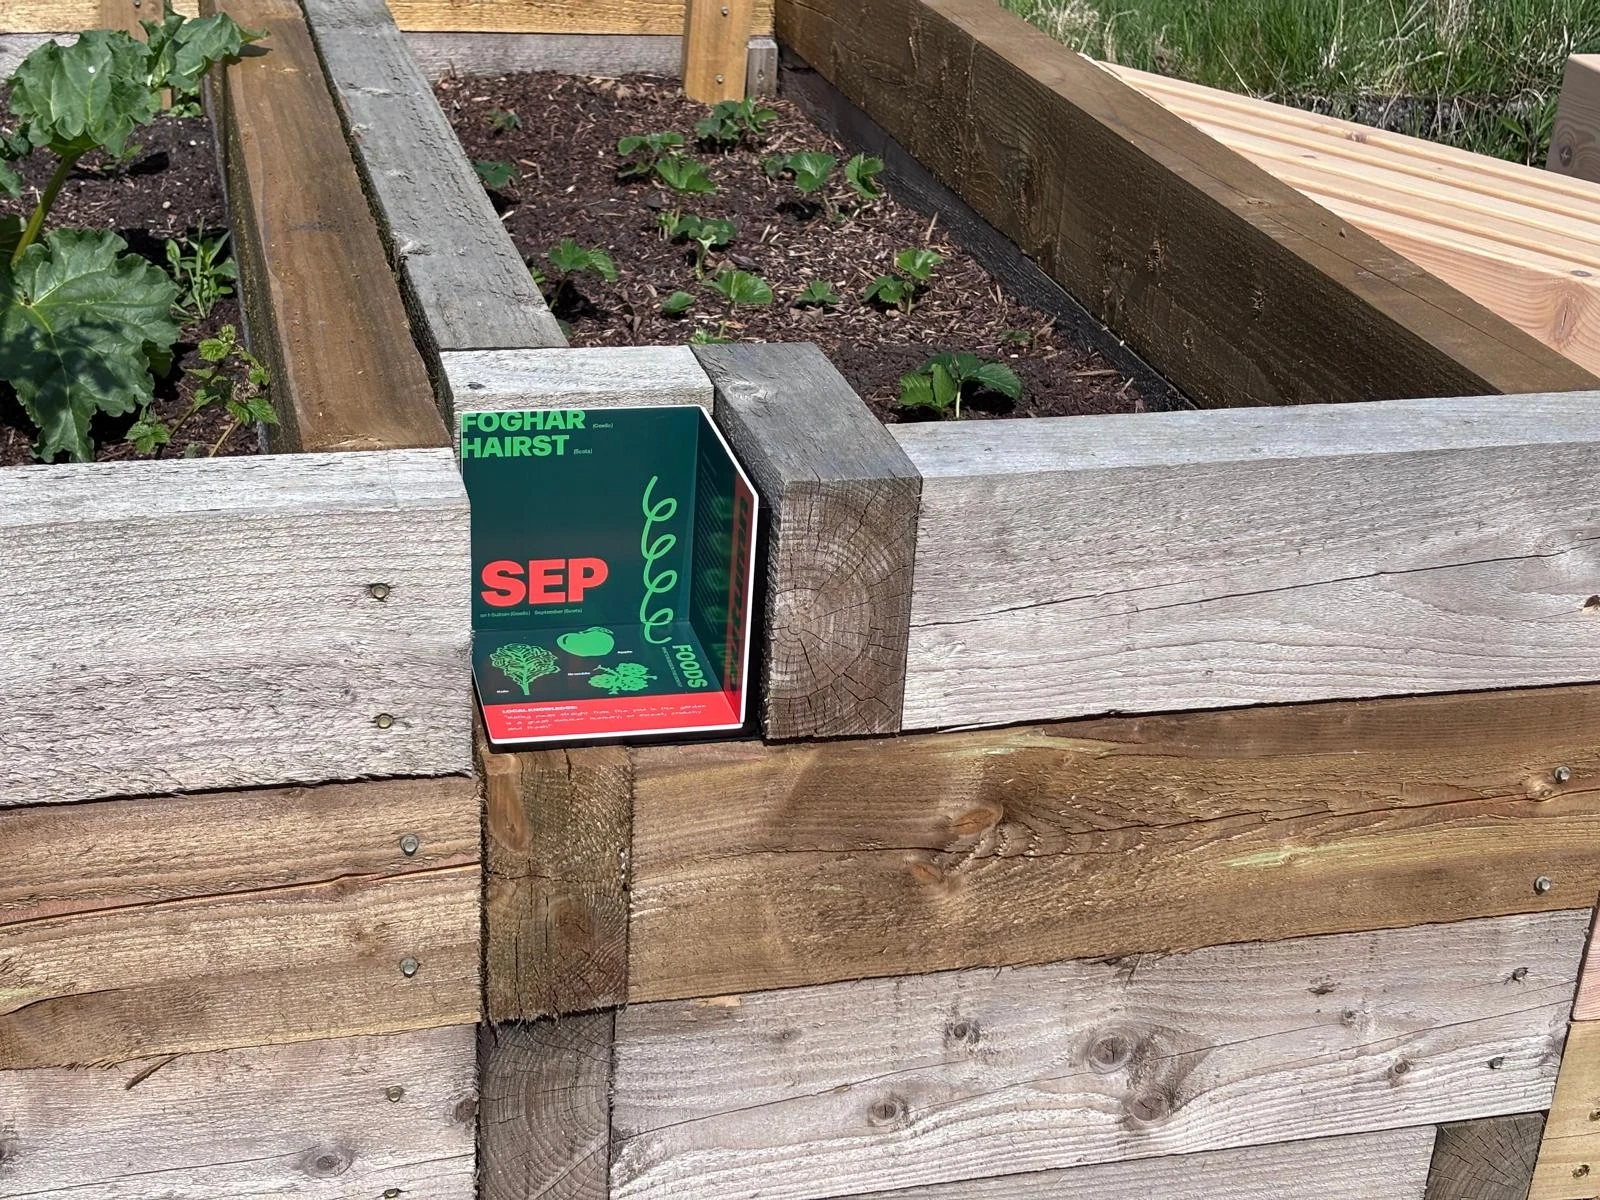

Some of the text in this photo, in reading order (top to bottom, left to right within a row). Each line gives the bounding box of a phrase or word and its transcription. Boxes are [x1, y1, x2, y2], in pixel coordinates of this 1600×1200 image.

[463, 410, 586, 432] FOGHAR
[463, 435, 570, 458] HAIRST
[481, 557, 609, 607] SEP
[672, 644, 708, 689] FOODS
